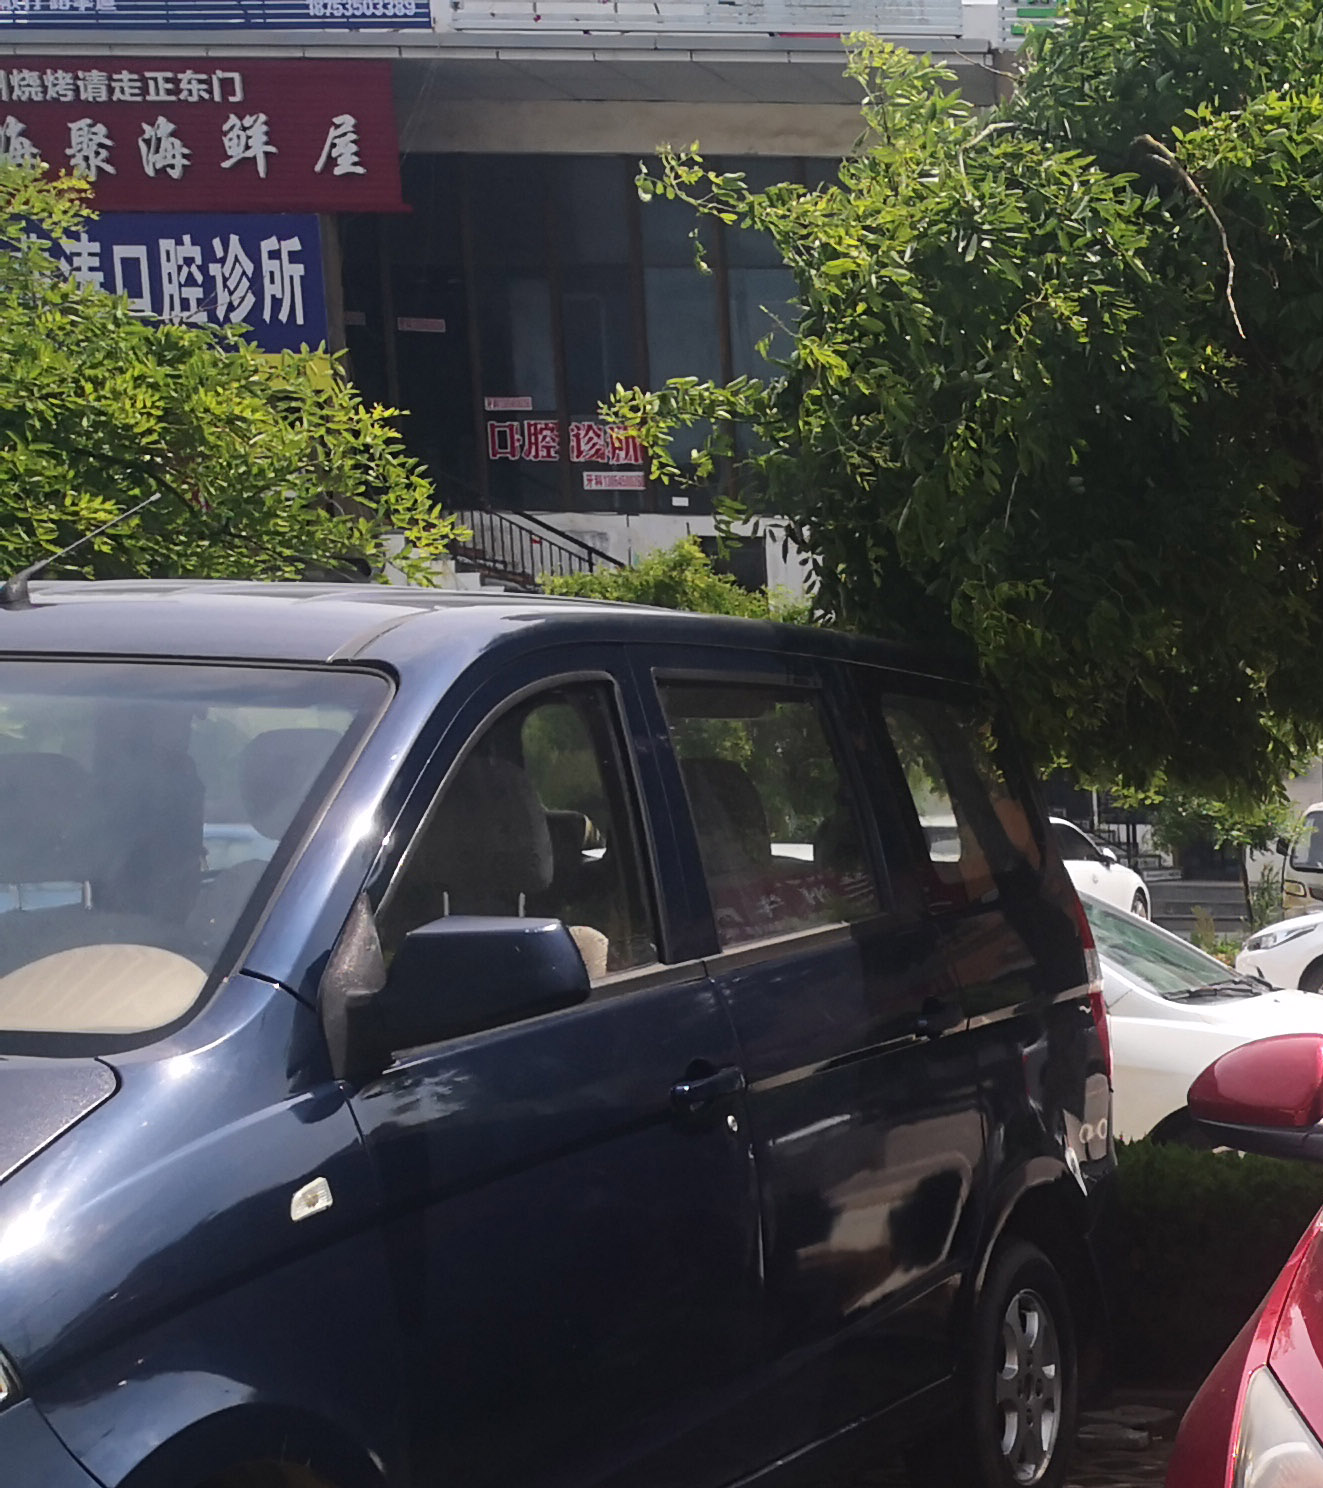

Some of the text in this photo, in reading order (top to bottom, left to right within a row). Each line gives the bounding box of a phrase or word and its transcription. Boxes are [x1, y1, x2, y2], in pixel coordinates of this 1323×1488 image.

[0, 69, 244, 102] 烧烤请走正东门
[488, 420, 645, 465] 口腔诊所
